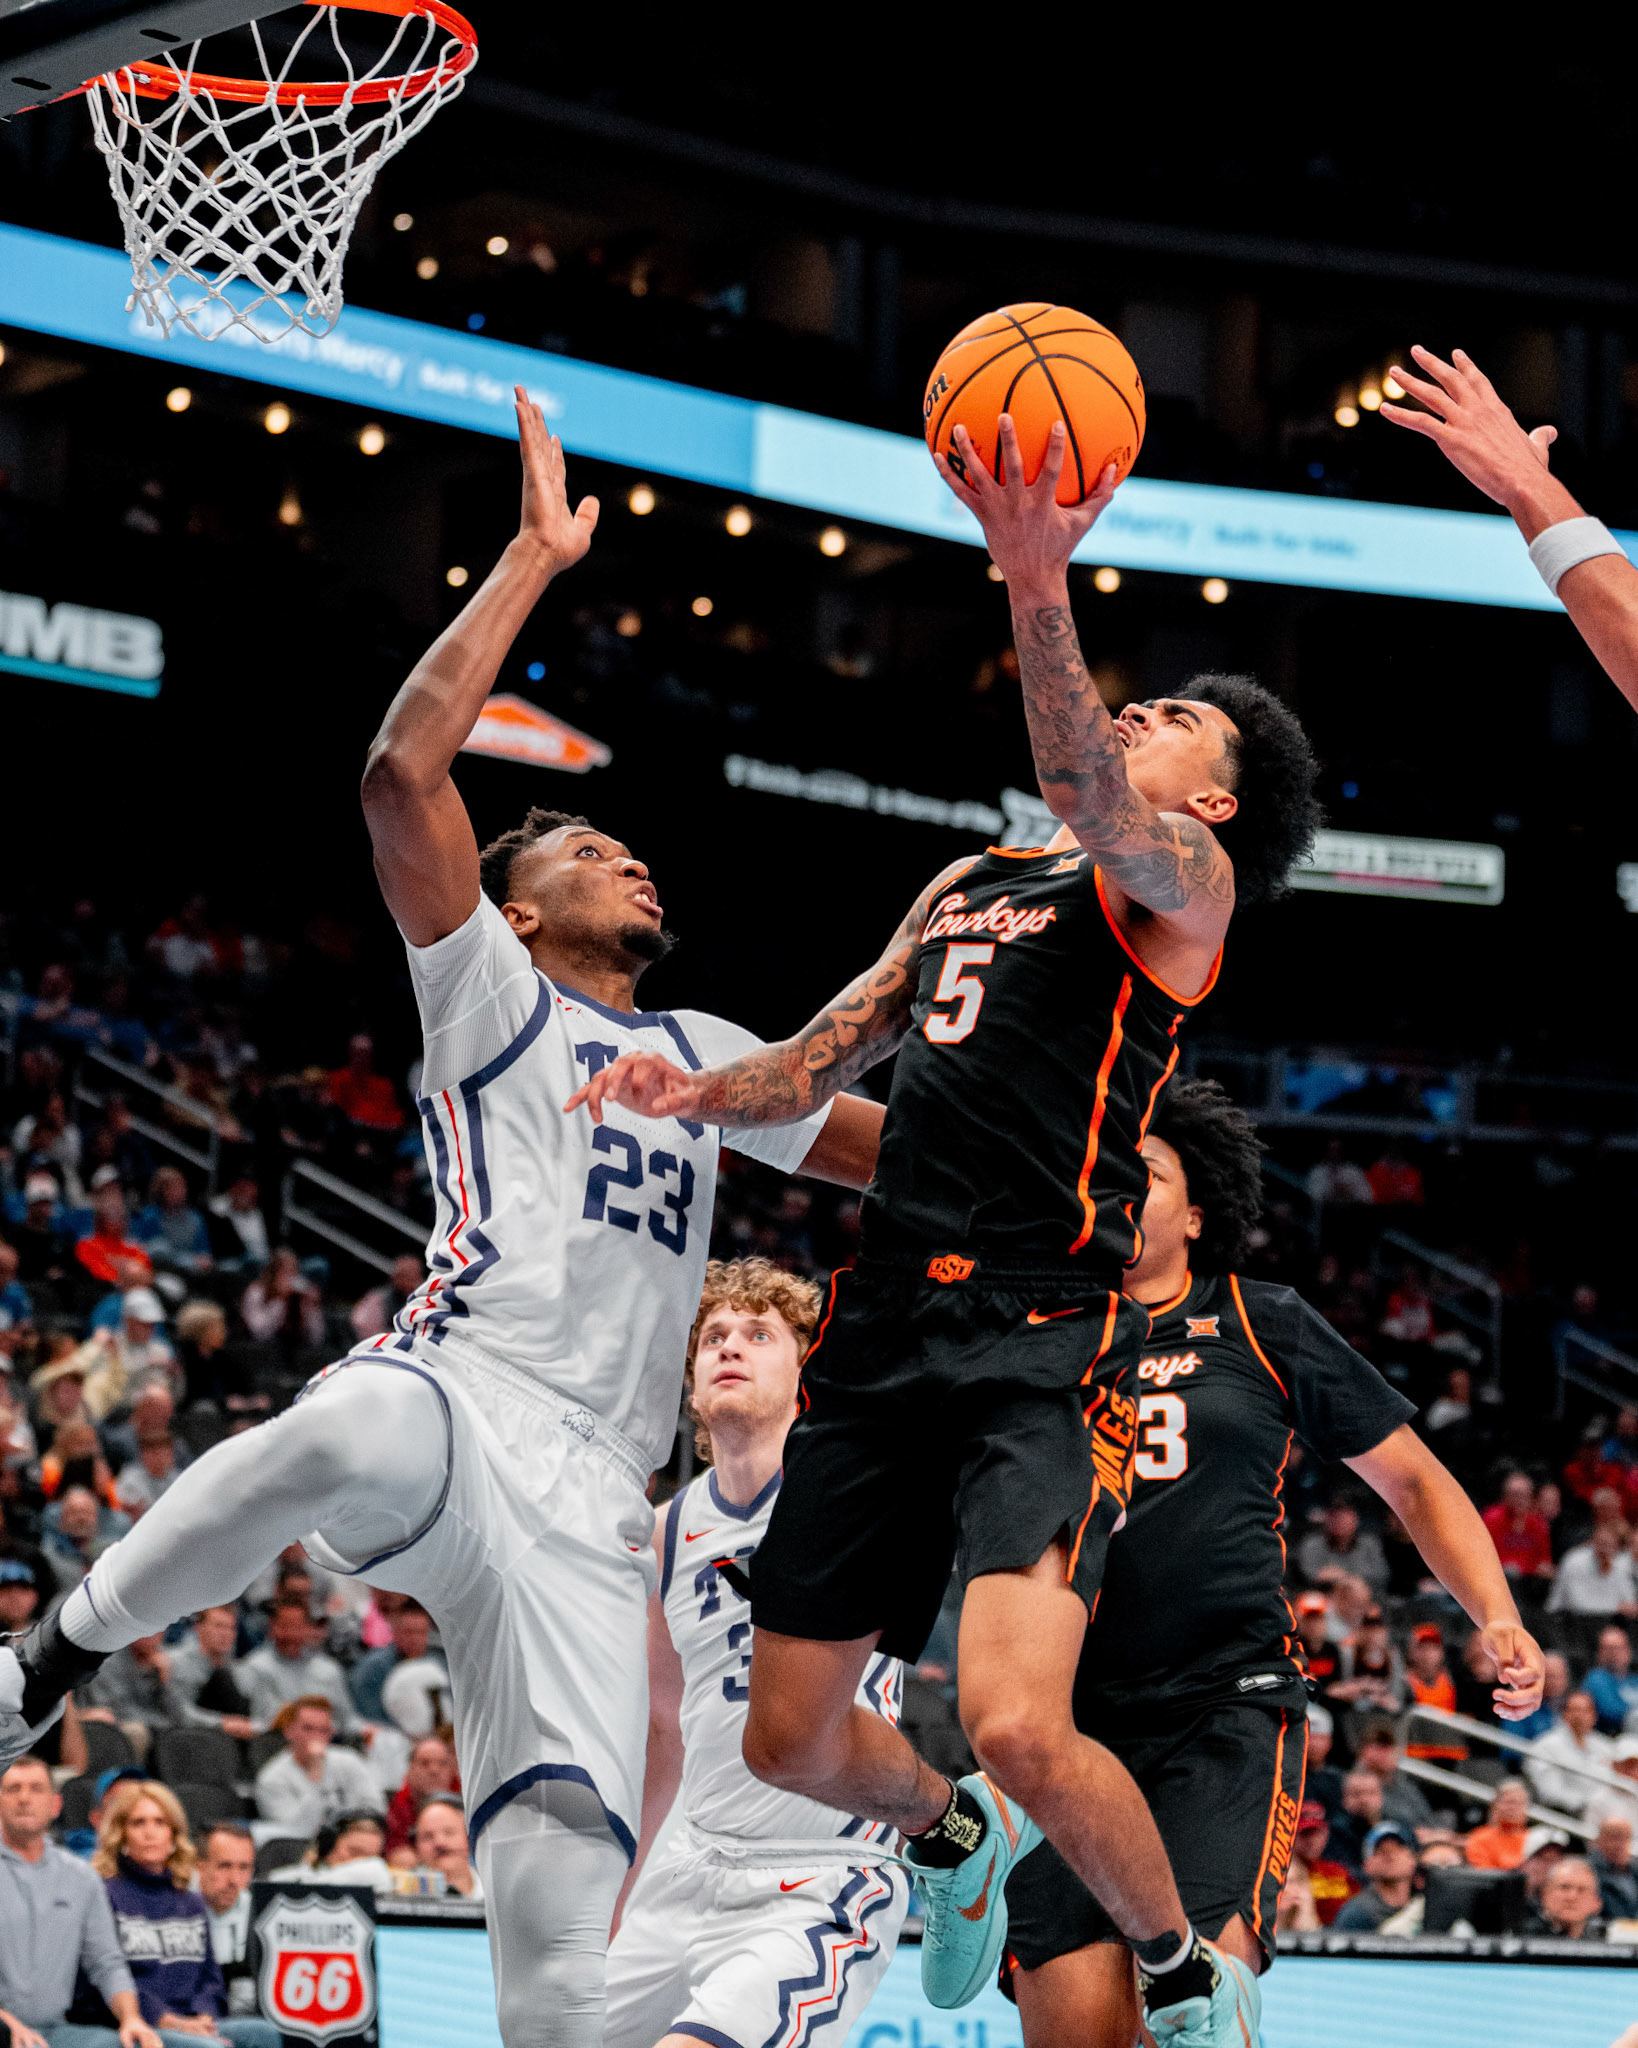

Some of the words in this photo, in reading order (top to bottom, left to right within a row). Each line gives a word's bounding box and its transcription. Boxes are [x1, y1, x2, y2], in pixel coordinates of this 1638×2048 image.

[920, 892, 1056, 943] Cowboys
[923, 942, 996, 1043] 5
[583, 1124, 695, 1257] 23
[928, 1254, 975, 1284] OSU
[1138, 1351, 1203, 1387] oys
[1268, 1791, 1297, 1885] POKES
[276, 1922, 356, 1946] PHILLIPS
[282, 1957, 354, 2012] 66
